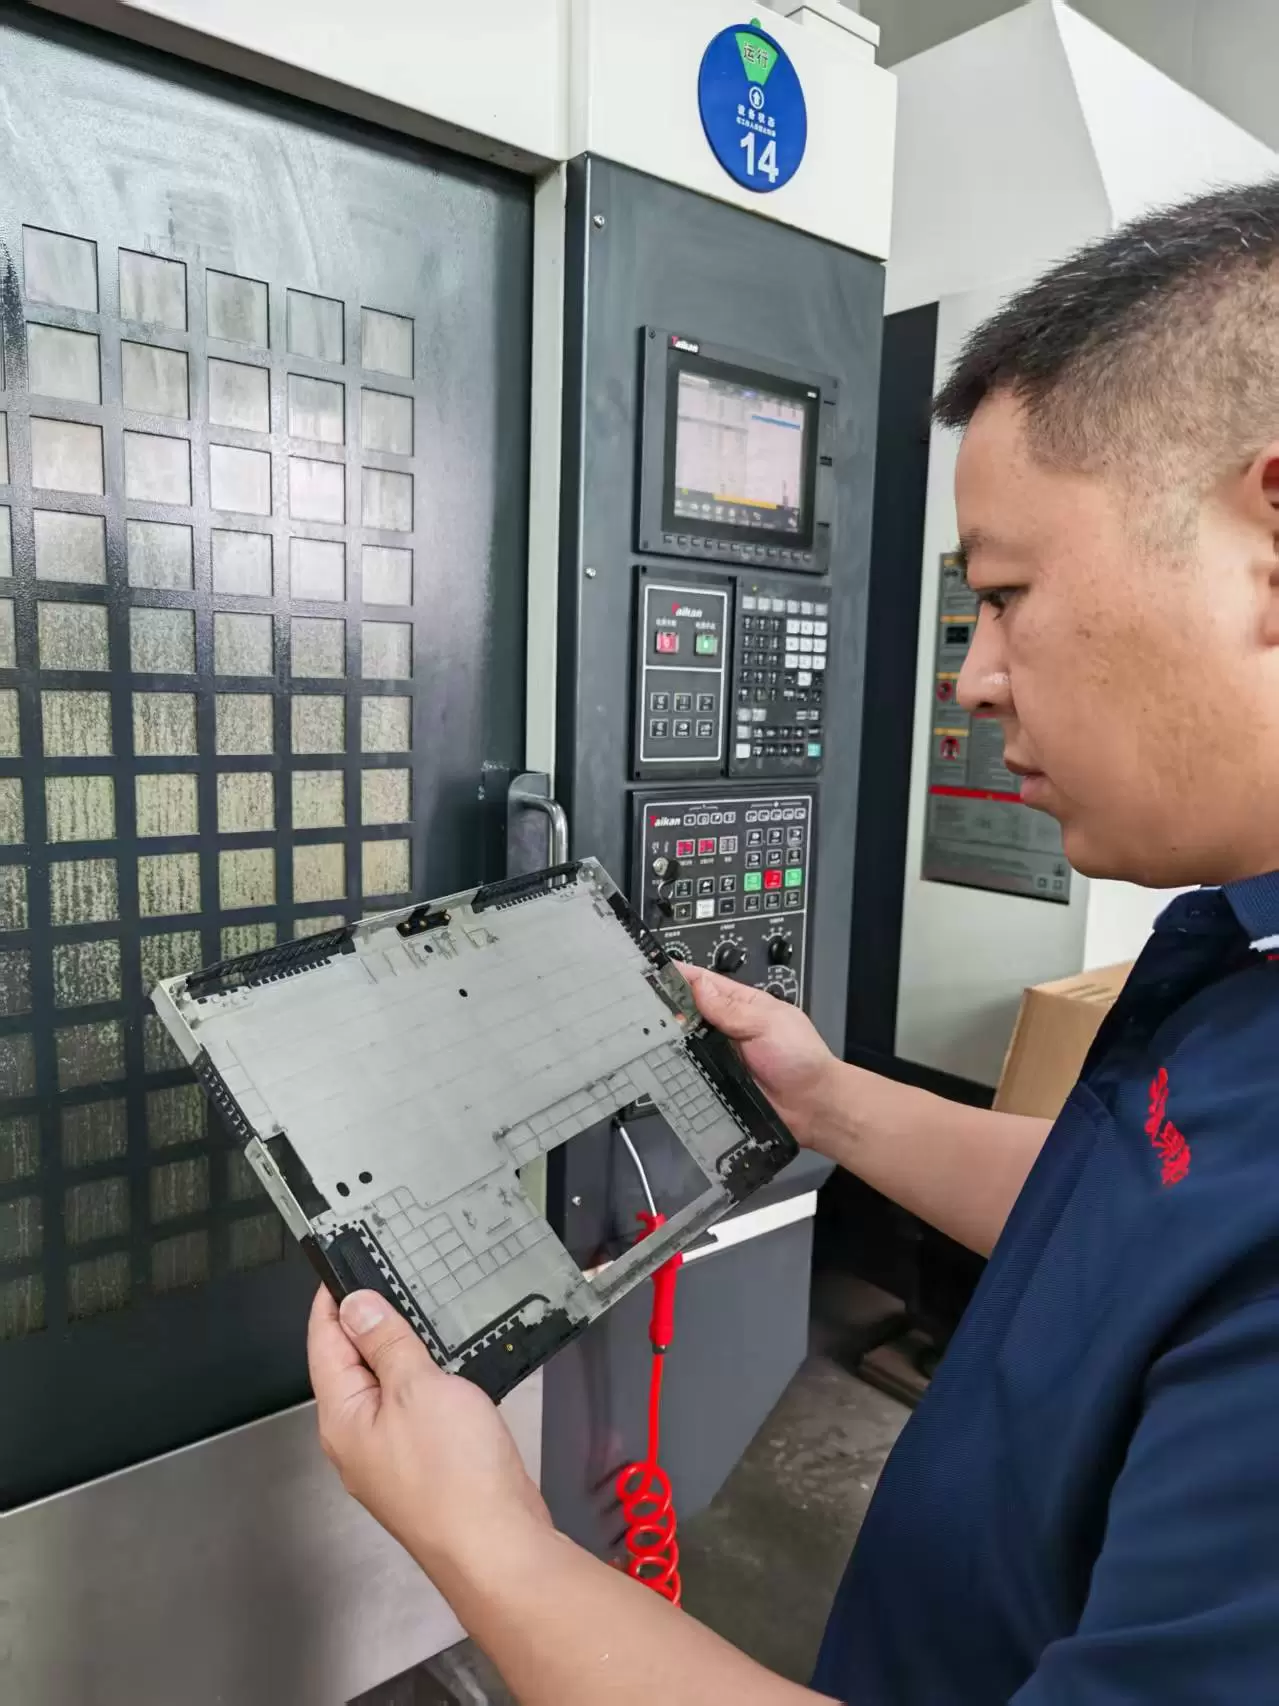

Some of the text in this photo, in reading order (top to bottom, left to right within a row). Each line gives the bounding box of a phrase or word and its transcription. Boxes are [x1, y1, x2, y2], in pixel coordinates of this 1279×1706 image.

[743, 41, 768, 68] 运行
[740, 132, 779, 183] 14
[650, 815, 681, 828] Taikan
